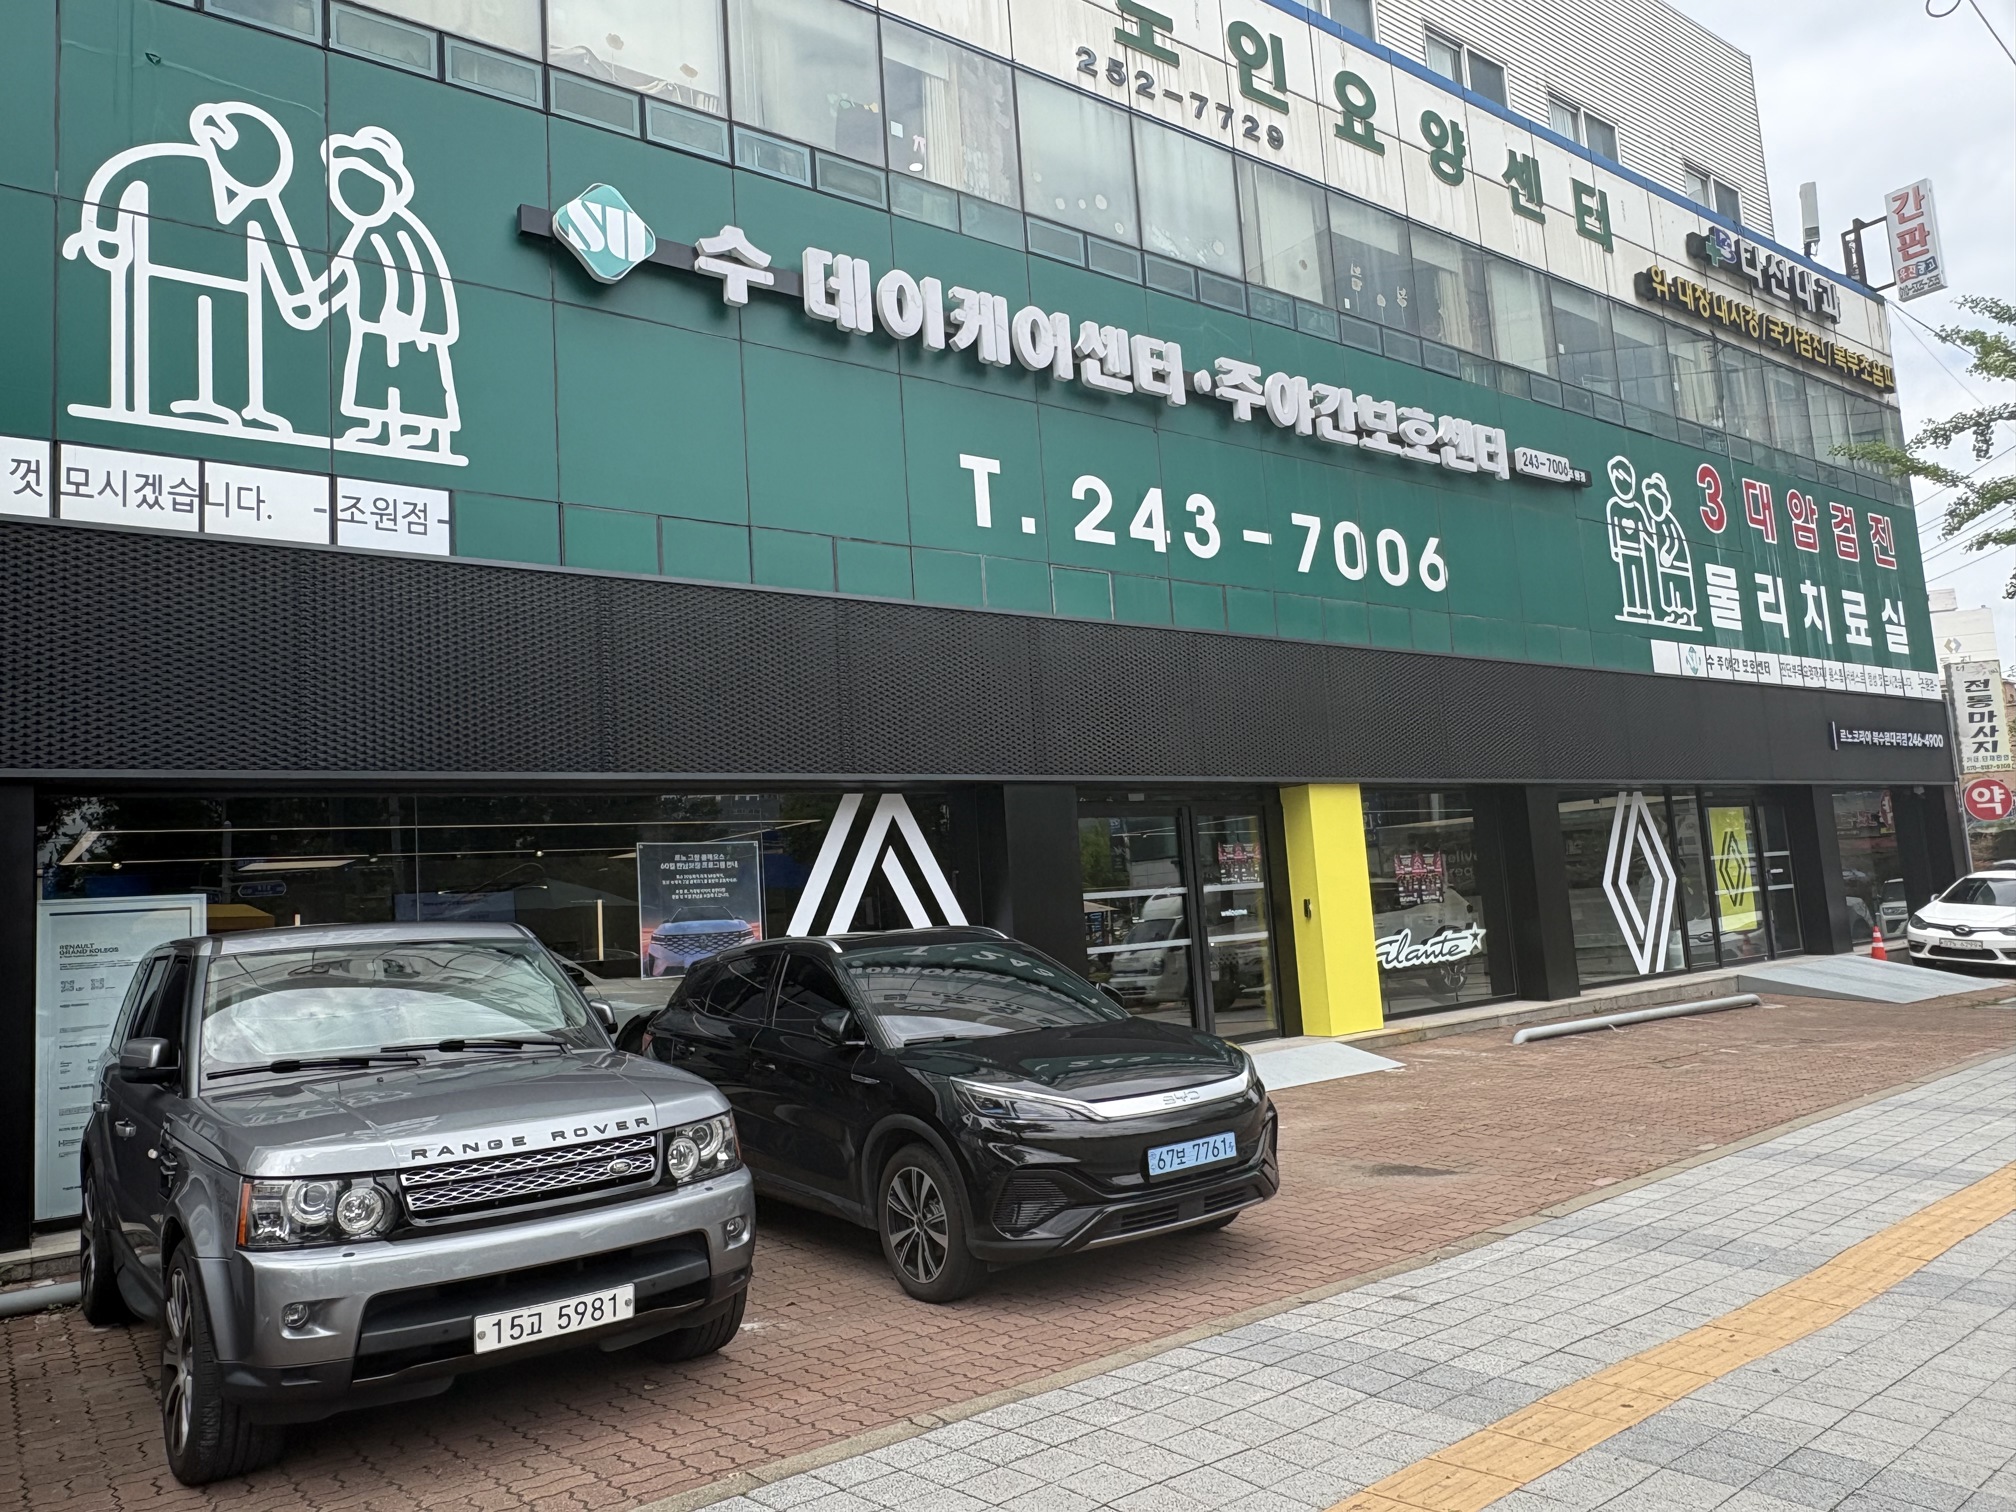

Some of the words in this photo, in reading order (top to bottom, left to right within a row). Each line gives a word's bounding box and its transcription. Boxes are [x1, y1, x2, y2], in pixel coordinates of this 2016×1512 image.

[1076, 46, 1284, 150] 252-7729
[1892, 185, 1930, 262] 간판
[694, 224, 774, 307] 수
[1768, 315, 1826, 364] 국가검진
[9, 458, 42, 498] 껏
[1522, 452, 1569, 477] 243-7006
[1071, 475, 1449, 592] 243-7006
[1704, 563, 1910, 655] 물리치료실
[1840, 729, 1872, 745] 르노코리아
[1908, 732, 1944, 748] 246-4900
[1972, 786, 2006, 815] 약
[410, 1136, 527, 1161] RANGE
[550, 1116, 651, 1142] ROVER
[1157, 1147, 1186, 1170] 67보
[1192, 1137, 1227, 1162] 7761
[491, 1313, 543, 1345] 15고
[556, 1293, 619, 1330] 5981
